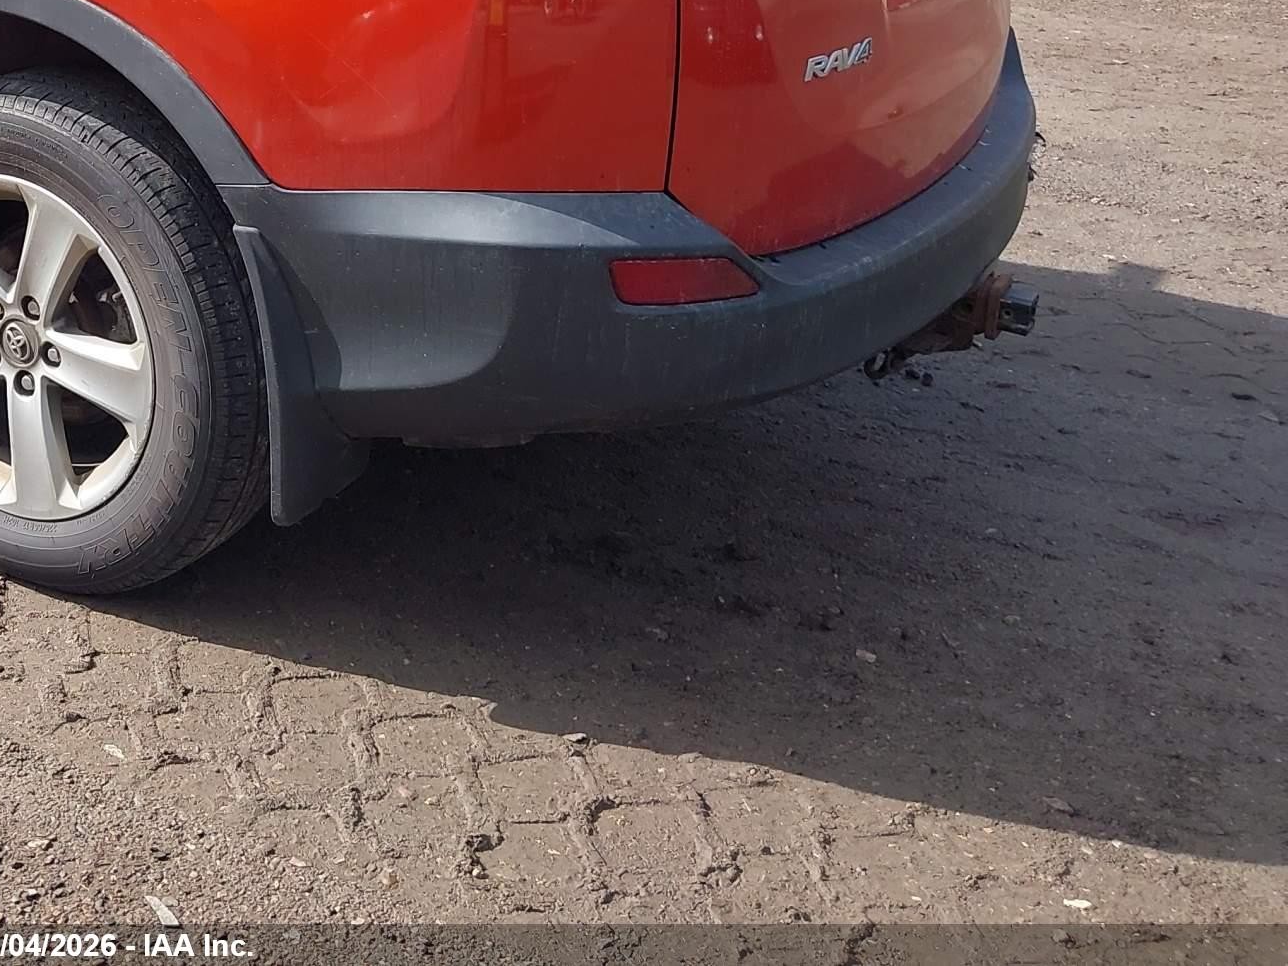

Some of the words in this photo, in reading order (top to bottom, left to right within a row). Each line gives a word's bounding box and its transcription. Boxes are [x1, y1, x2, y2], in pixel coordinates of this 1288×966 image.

[804, 37, 873, 83] RAV4
[97, 193, 192, 352] OPEN
[78, 373, 200, 579] COUNTRY
